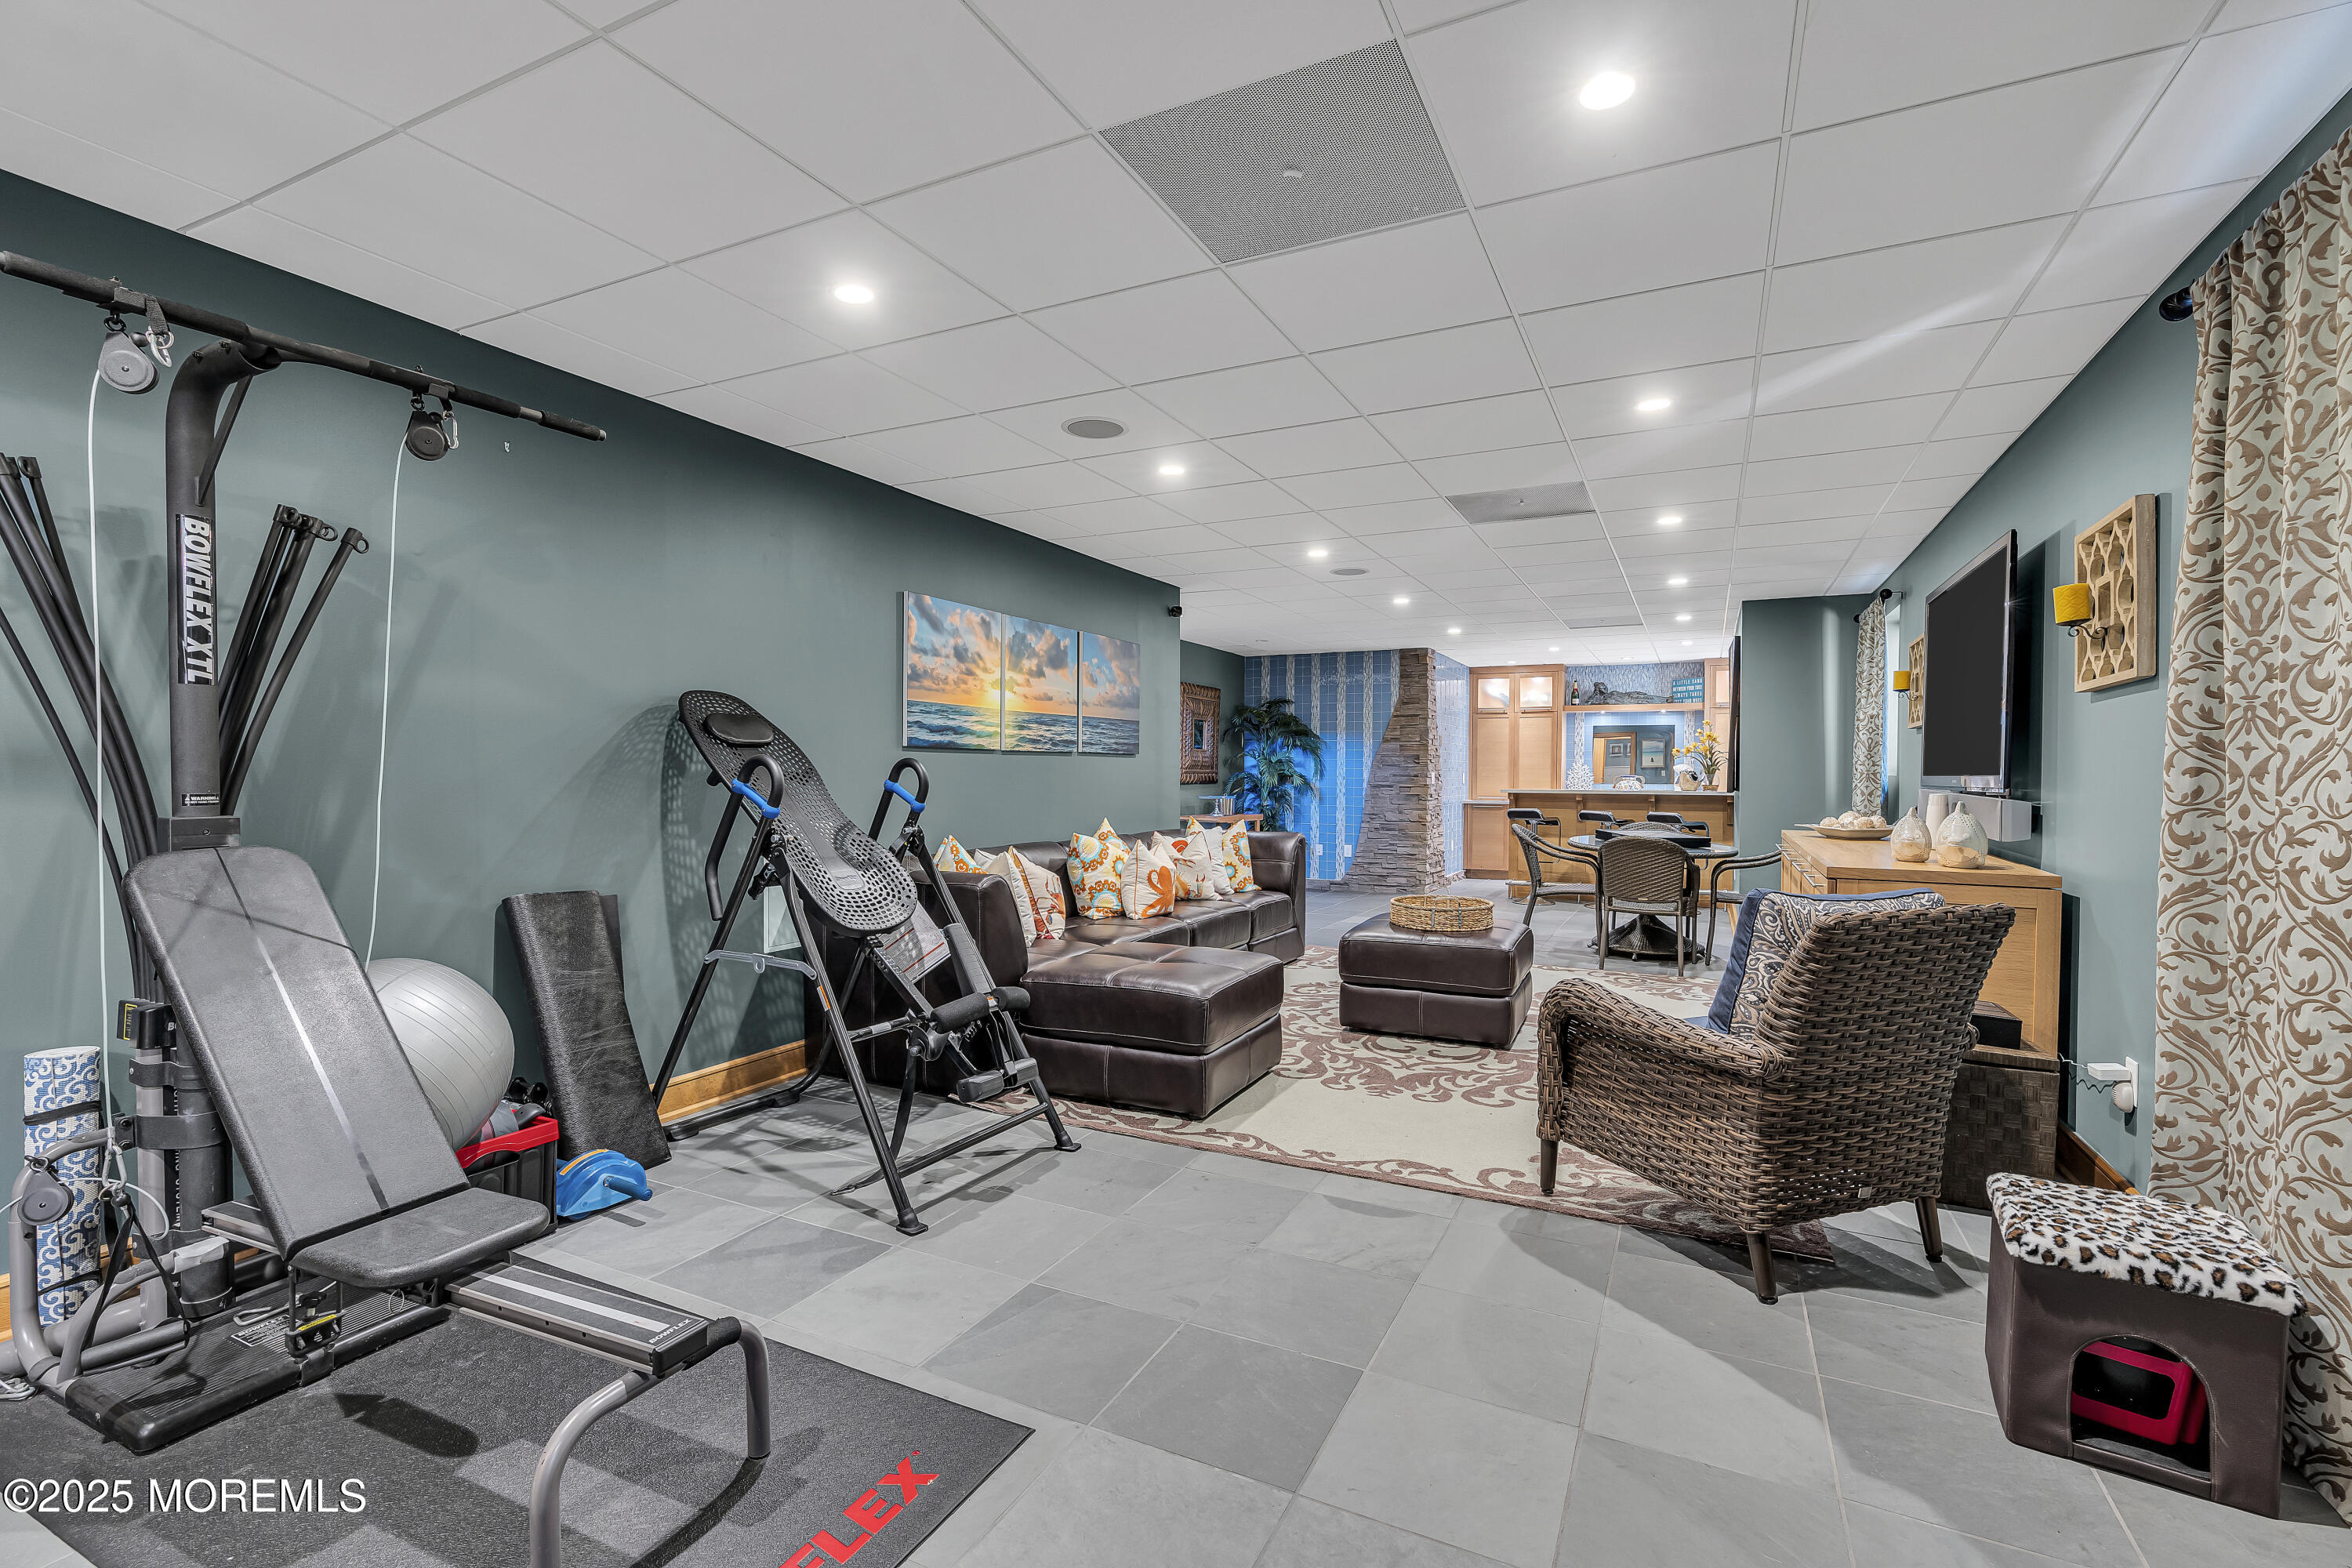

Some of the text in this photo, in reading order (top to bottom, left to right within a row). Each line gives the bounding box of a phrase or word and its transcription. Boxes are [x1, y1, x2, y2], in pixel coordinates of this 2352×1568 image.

[183, 516, 213, 683] BOWFLEX XTL
[648, 1318, 693, 1344] BOWFLEX
